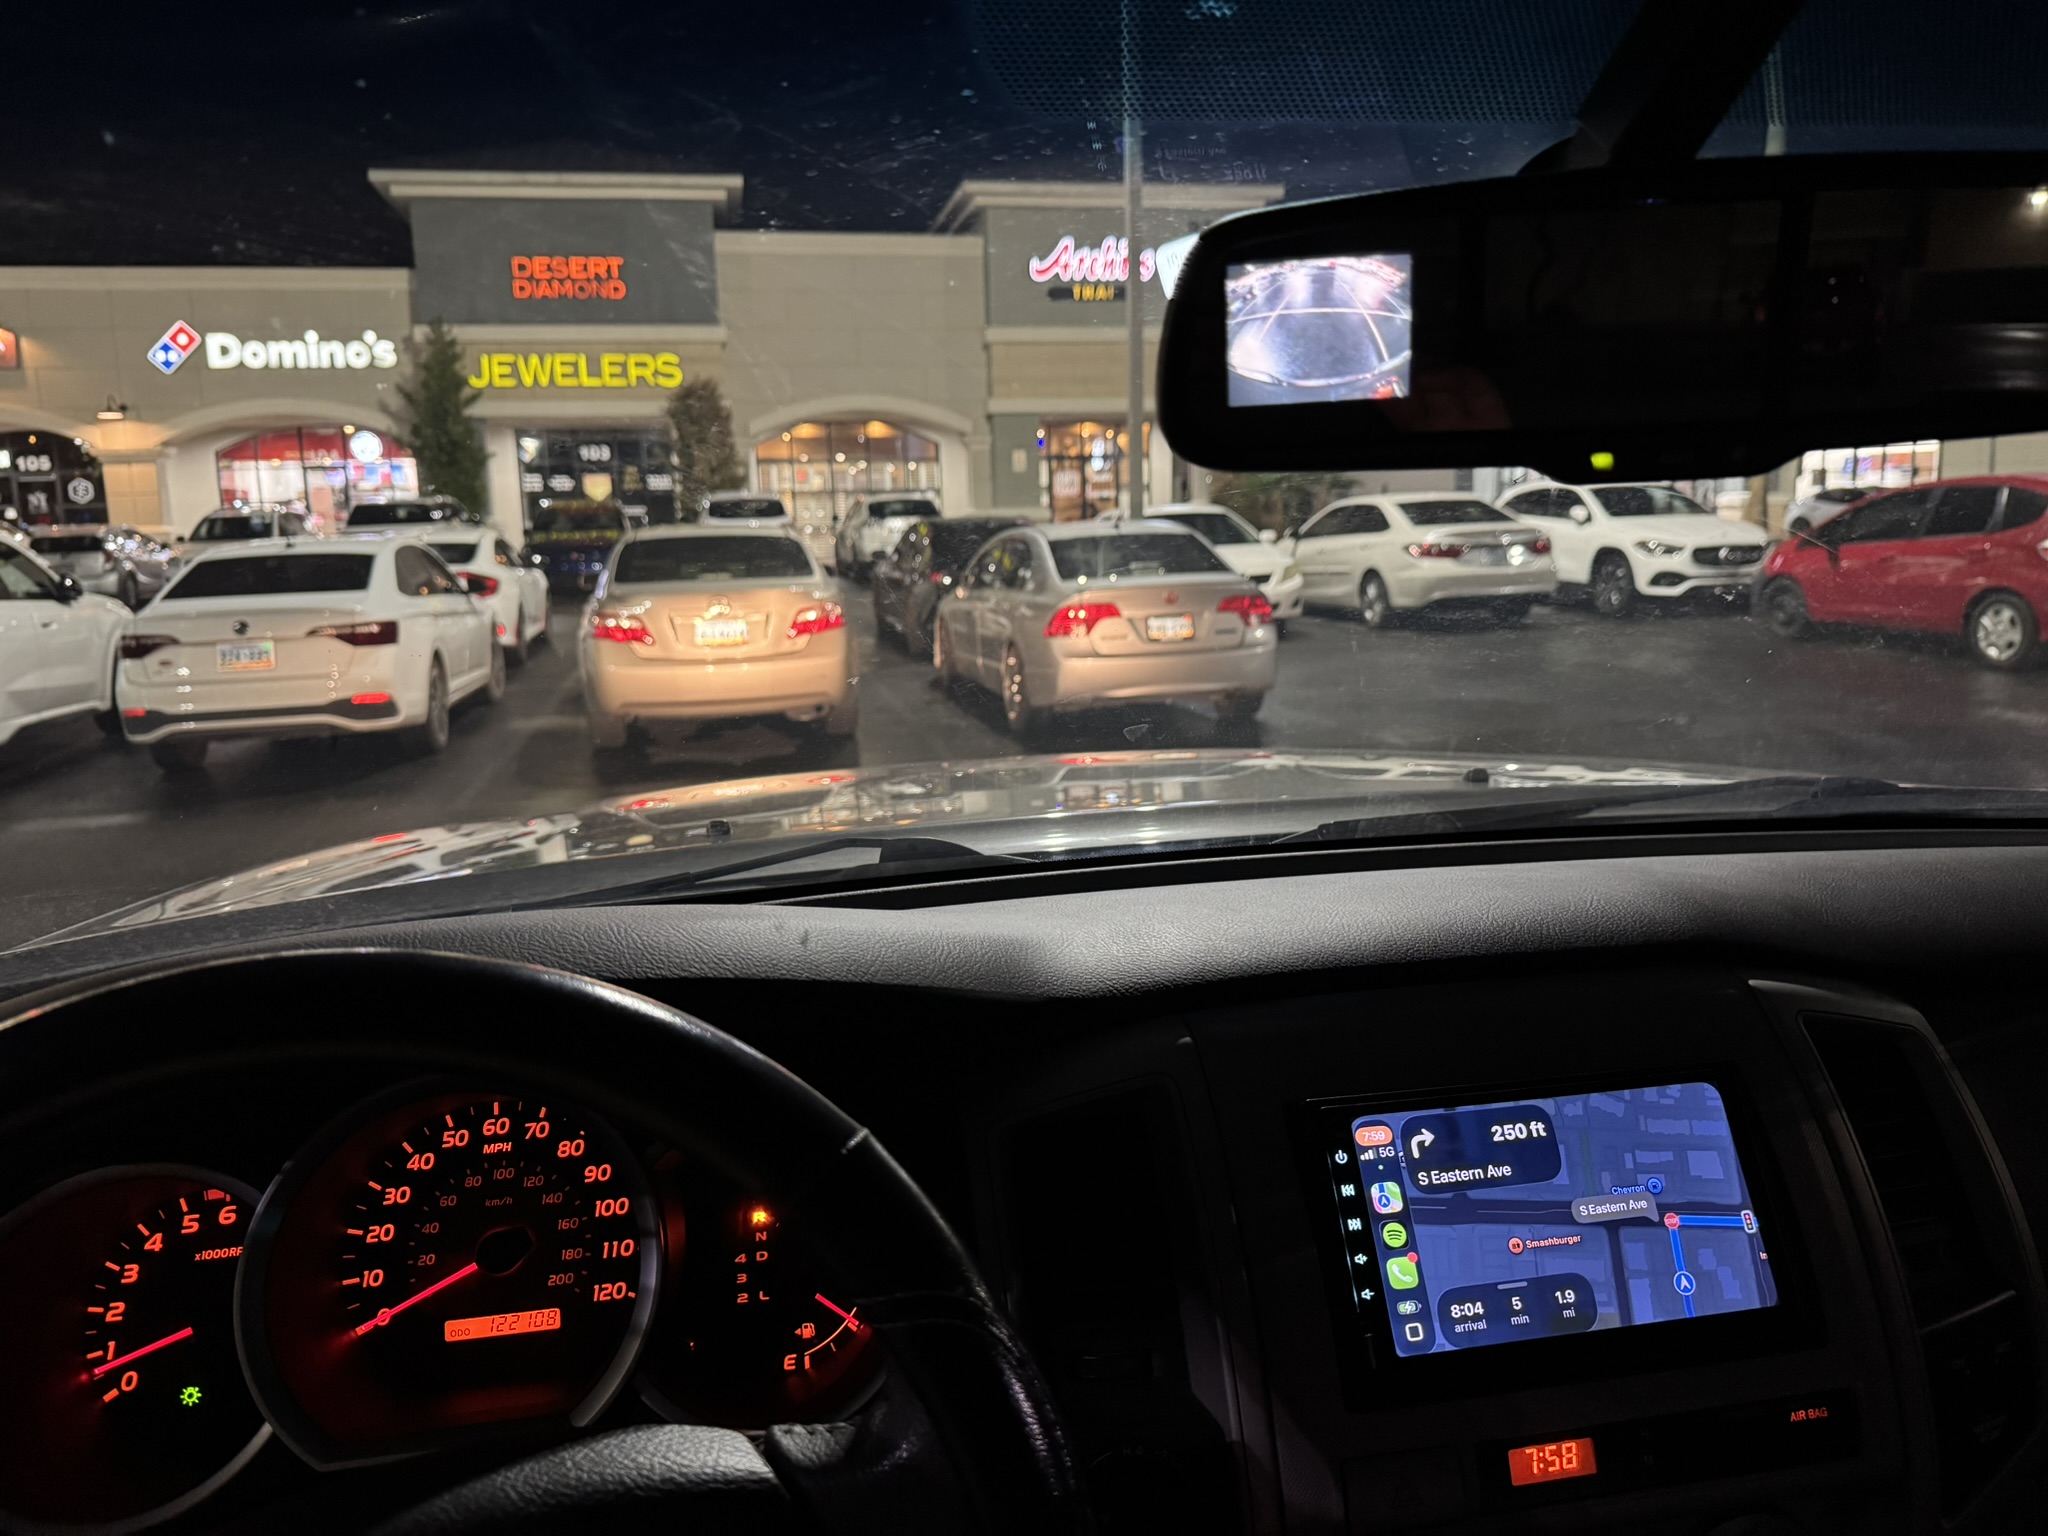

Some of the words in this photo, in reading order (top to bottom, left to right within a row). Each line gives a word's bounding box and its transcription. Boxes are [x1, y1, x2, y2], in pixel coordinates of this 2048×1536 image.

[510, 255, 625, 280] DESERT
[1029, 235, 1156, 282] Archis
[510, 278, 628, 300] DIAMOND
[204, 328, 398, 370] Domino's
[467, 350, 684, 391] JEWELERS
[14, 454, 53, 473] 105
[482, 1117, 510, 1136] 60
[524, 1121, 550, 1140] 70
[1490, 1122, 1528, 1142] 250
[1530, 1120, 1547, 1137] ft
[441, 1129, 469, 1148] 50
[1361, 1130, 1386, 1142] 7:59
[483, 1142, 512, 1154] MPH
[557, 1139, 585, 1158] 80
[1378, 1146, 1395, 1158] 5G
[406, 1152, 435, 1171] 40
[464, 1175, 482, 1188] 80
[493, 1167, 515, 1180] 100
[523, 1175, 545, 1187] 120
[584, 1163, 612, 1183] 90
[1418, 1172, 1429, 1186] S
[1431, 1168, 1484, 1184] Eastern
[1487, 1164, 1512, 1178] Ave
[382, 1186, 411, 1205] 30
[1611, 1183, 1646, 1195] Chevron
[439, 1195, 457, 1207] 60
[485, 1196, 513, 1207] km/h
[542, 1192, 563, 1205] 140
[595, 1197, 630, 1218] 100
[1579, 1204, 1588, 1216] S
[1589, 1201, 1627, 1215] Eastern
[1629, 1198, 1648, 1210] Ave
[181, 1214, 200, 1234] 5
[218, 1205, 237, 1225] 6
[558, 1217, 579, 1230] 160
[752, 1210, 767, 1225] R
[366, 1223, 395, 1244] 20
[421, 1222, 440, 1234] 40
[755, 1231, 767, 1241] N
[143, 1233, 163, 1252] 4
[603, 1238, 635, 1259] 110
[1526, 1234, 1582, 1248] Smashburger
[417, 1253, 436, 1266] 20
[561, 1248, 583, 1260] 180
[734, 1253, 747, 1263] 4
[756, 1251, 769, 1262] D
[120, 1264, 140, 1284] 3
[362, 1269, 384, 1288] 10
[547, 1273, 574, 1286] 200
[736, 1273, 747, 1284] 3
[593, 1281, 627, 1302] 120
[737, 1293, 749, 1304] 2
[759, 1290, 770, 1300] L
[1554, 1290, 1576, 1304] 1.9
[1450, 1302, 1484, 1318] 8:04
[1511, 1296, 1522, 1310] 5
[105, 1302, 126, 1323] 2
[1510, 1314, 1530, 1326] min
[1562, 1308, 1576, 1318] mi
[449, 1326, 471, 1338] ODO
[488, 1309, 557, 1333] 122108
[1454, 1319, 1487, 1333] arrival
[106, 1340, 116, 1361] 1
[783, 1353, 797, 1371] E
[120, 1371, 139, 1392] 0
[1790, 1409, 1807, 1422] AIR
[1808, 1408, 1828, 1419] BAG
[1525, 1442, 1578, 1475] 7:58
